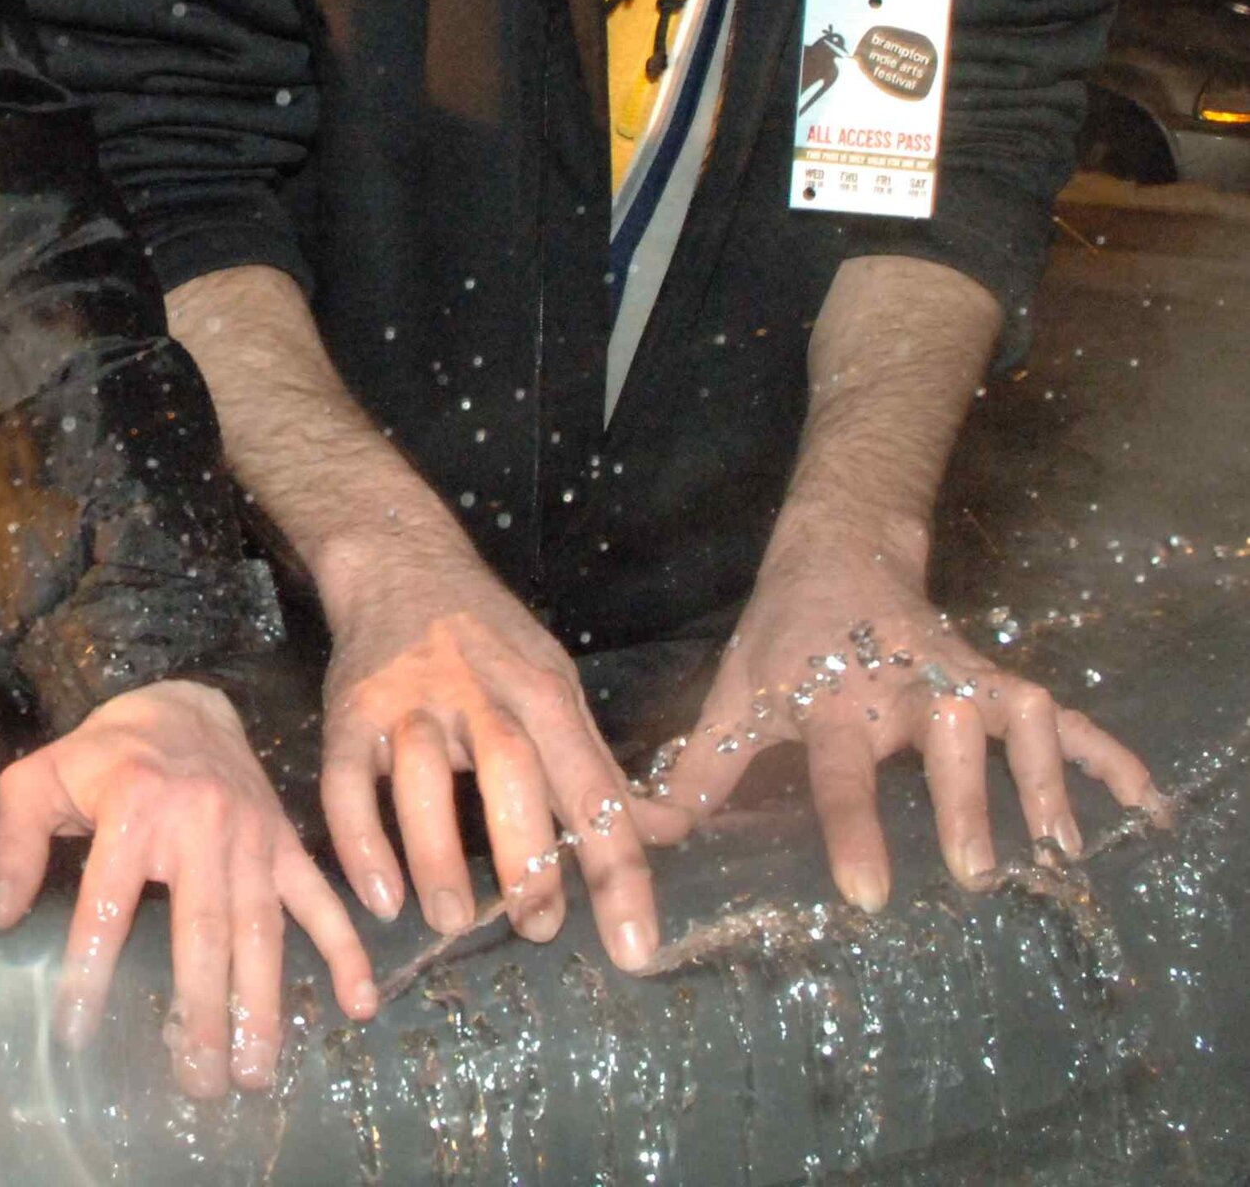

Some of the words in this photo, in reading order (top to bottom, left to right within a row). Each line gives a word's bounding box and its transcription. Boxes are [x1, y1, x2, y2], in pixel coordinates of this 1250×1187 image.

[871, 33, 930, 65] brampton
[868, 51, 898, 69] indie
[899, 61, 924, 79] arts
[873, 66, 917, 90] festival
[807, 125, 831, 144] ALL
[838, 128, 891, 148] ACCESS
[897, 132, 932, 152] PASS
